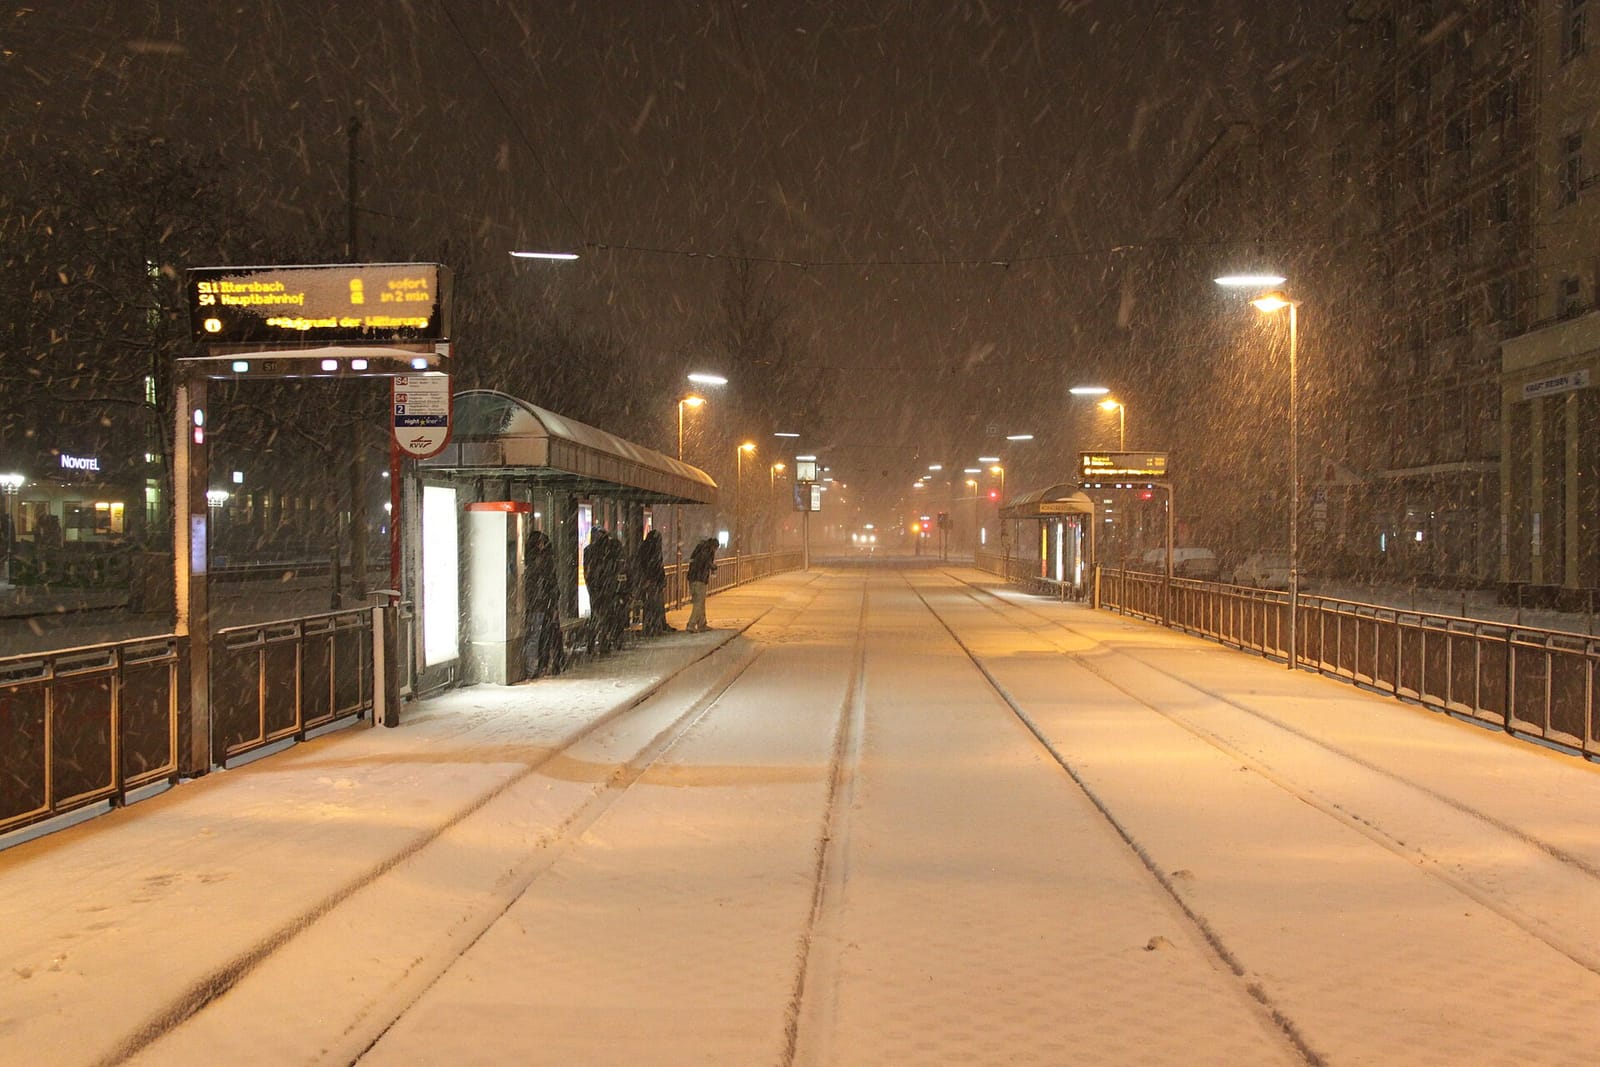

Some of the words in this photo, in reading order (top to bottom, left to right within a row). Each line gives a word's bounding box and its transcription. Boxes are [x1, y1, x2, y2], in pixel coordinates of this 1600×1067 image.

[197, 282, 218, 293] S11
[220, 281, 285, 293] Ittersbach
[388, 277, 428, 290] sofort
[198, 295, 216, 306] S4
[221, 293, 305, 307] Hauptbahnhof
[394, 290, 404, 302] 2
[405, 290, 430, 302] min
[396, 376, 408, 385] S4
[397, 405, 404, 414] 2
[404, 418, 420, 426] night
[61, 454, 100, 471] NOVOTEL
